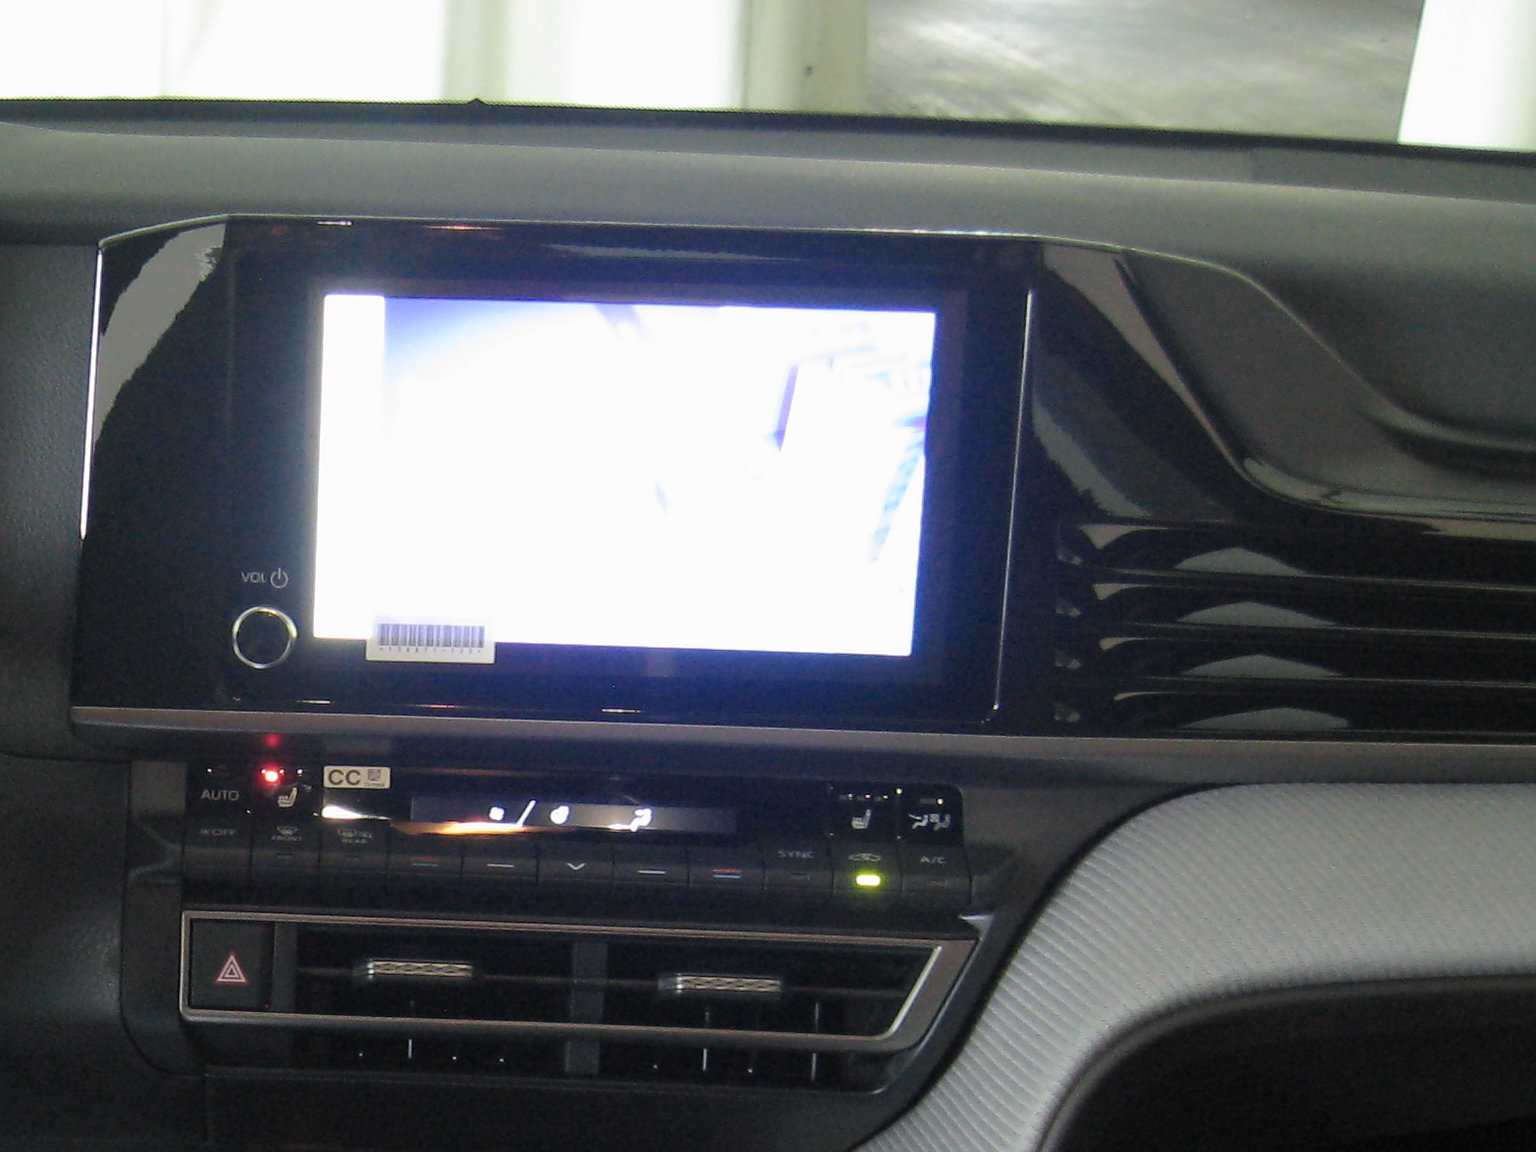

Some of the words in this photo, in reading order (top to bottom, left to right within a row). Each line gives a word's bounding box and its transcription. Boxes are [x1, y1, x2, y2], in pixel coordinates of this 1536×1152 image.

[241, 571, 266, 583] VOL
[328, 769, 361, 785] CC
[201, 789, 240, 801] AUTO
[919, 856, 947, 865] A/C
